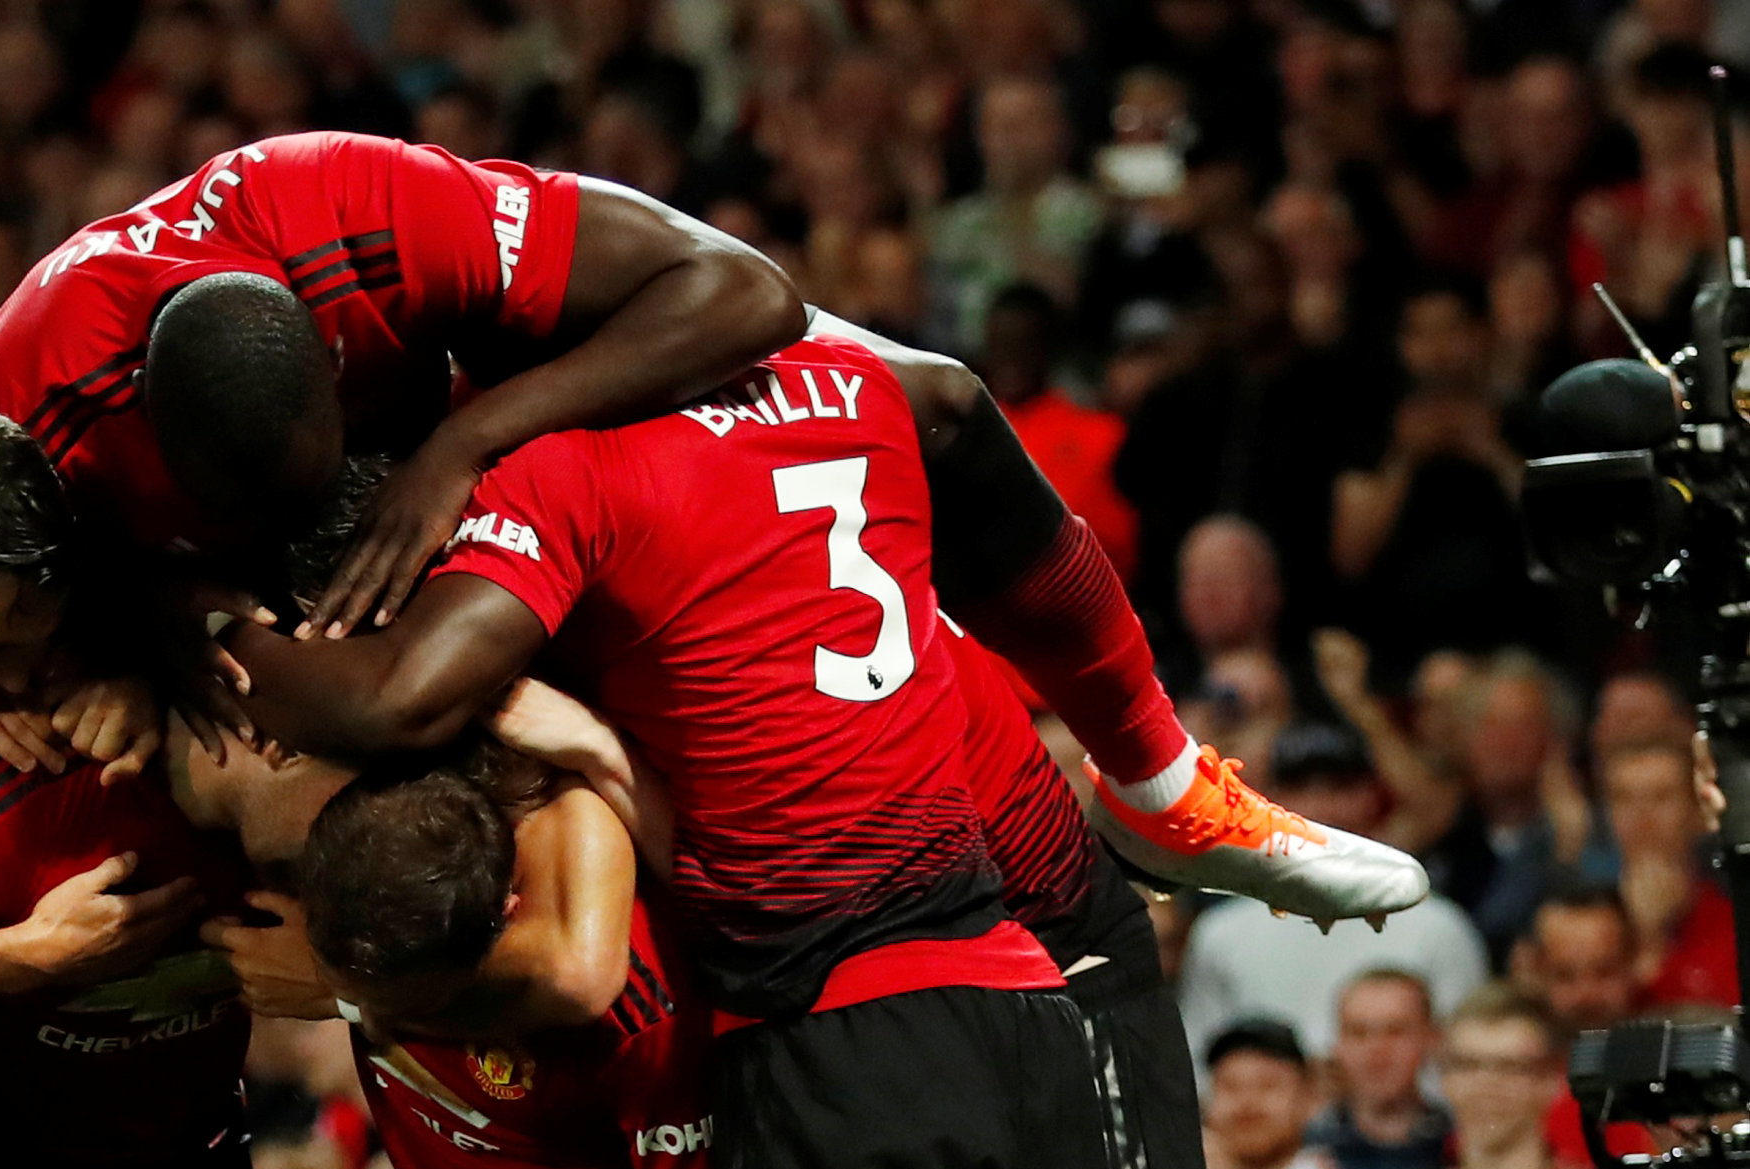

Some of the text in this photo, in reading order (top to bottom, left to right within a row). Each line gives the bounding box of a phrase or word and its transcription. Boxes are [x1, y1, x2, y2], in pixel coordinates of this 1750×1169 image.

[40, 144, 267, 288] LUKAKU
[771, 455, 916, 703] 3
[36, 1001, 233, 1054] CHEVROLE
[635, 1114, 714, 1157] KOH
